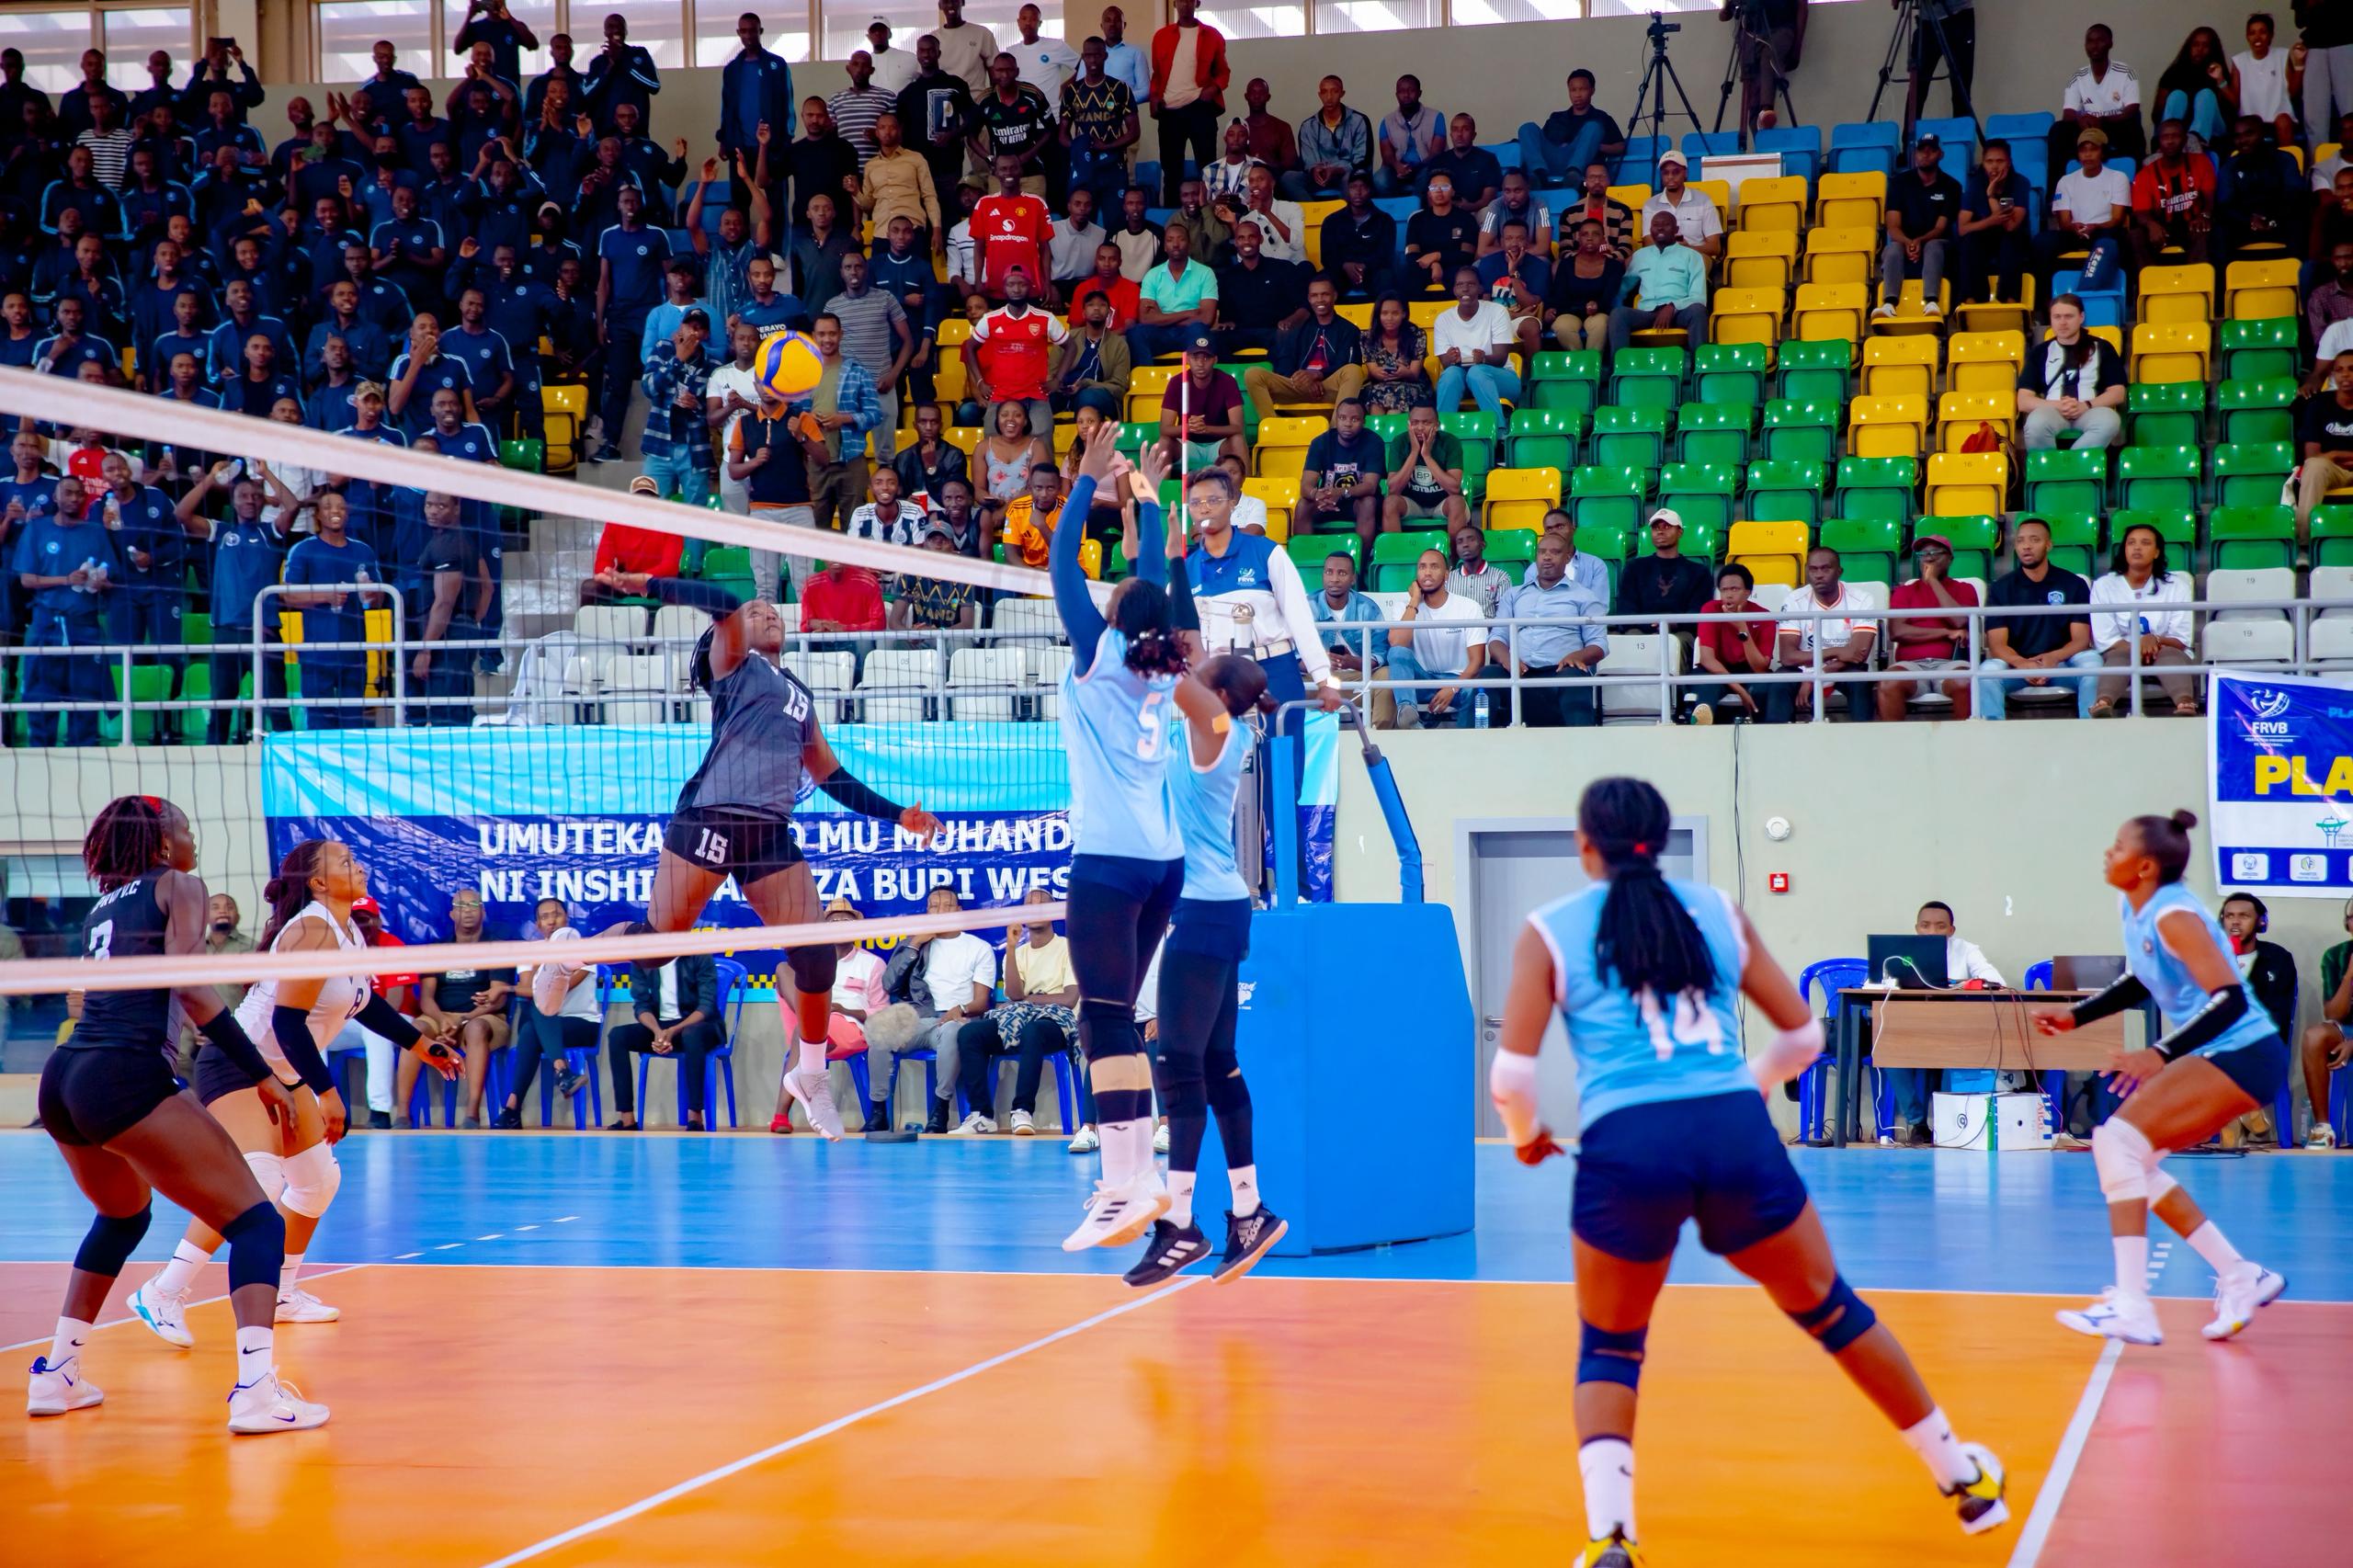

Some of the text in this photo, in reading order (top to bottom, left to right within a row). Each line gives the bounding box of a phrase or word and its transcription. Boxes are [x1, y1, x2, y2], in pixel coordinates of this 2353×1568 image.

[990, 234, 1029, 243] Snapdragon
[782, 683, 810, 722] 15
[1136, 691, 1162, 759] 5
[2251, 721, 2289, 734] FRVB
[2255, 755, 2353, 795] PLA
[479, 823, 664, 856] UMUTEKA
[818, 821, 876, 854] MU
[893, 819, 1074, 854] MUHAND
[694, 827, 729, 865] 15
[481, 870, 526, 903] NI
[813, 869, 861, 902] ZA
[985, 867, 1072, 902] WES
[1632, 983, 1724, 1062] 14
